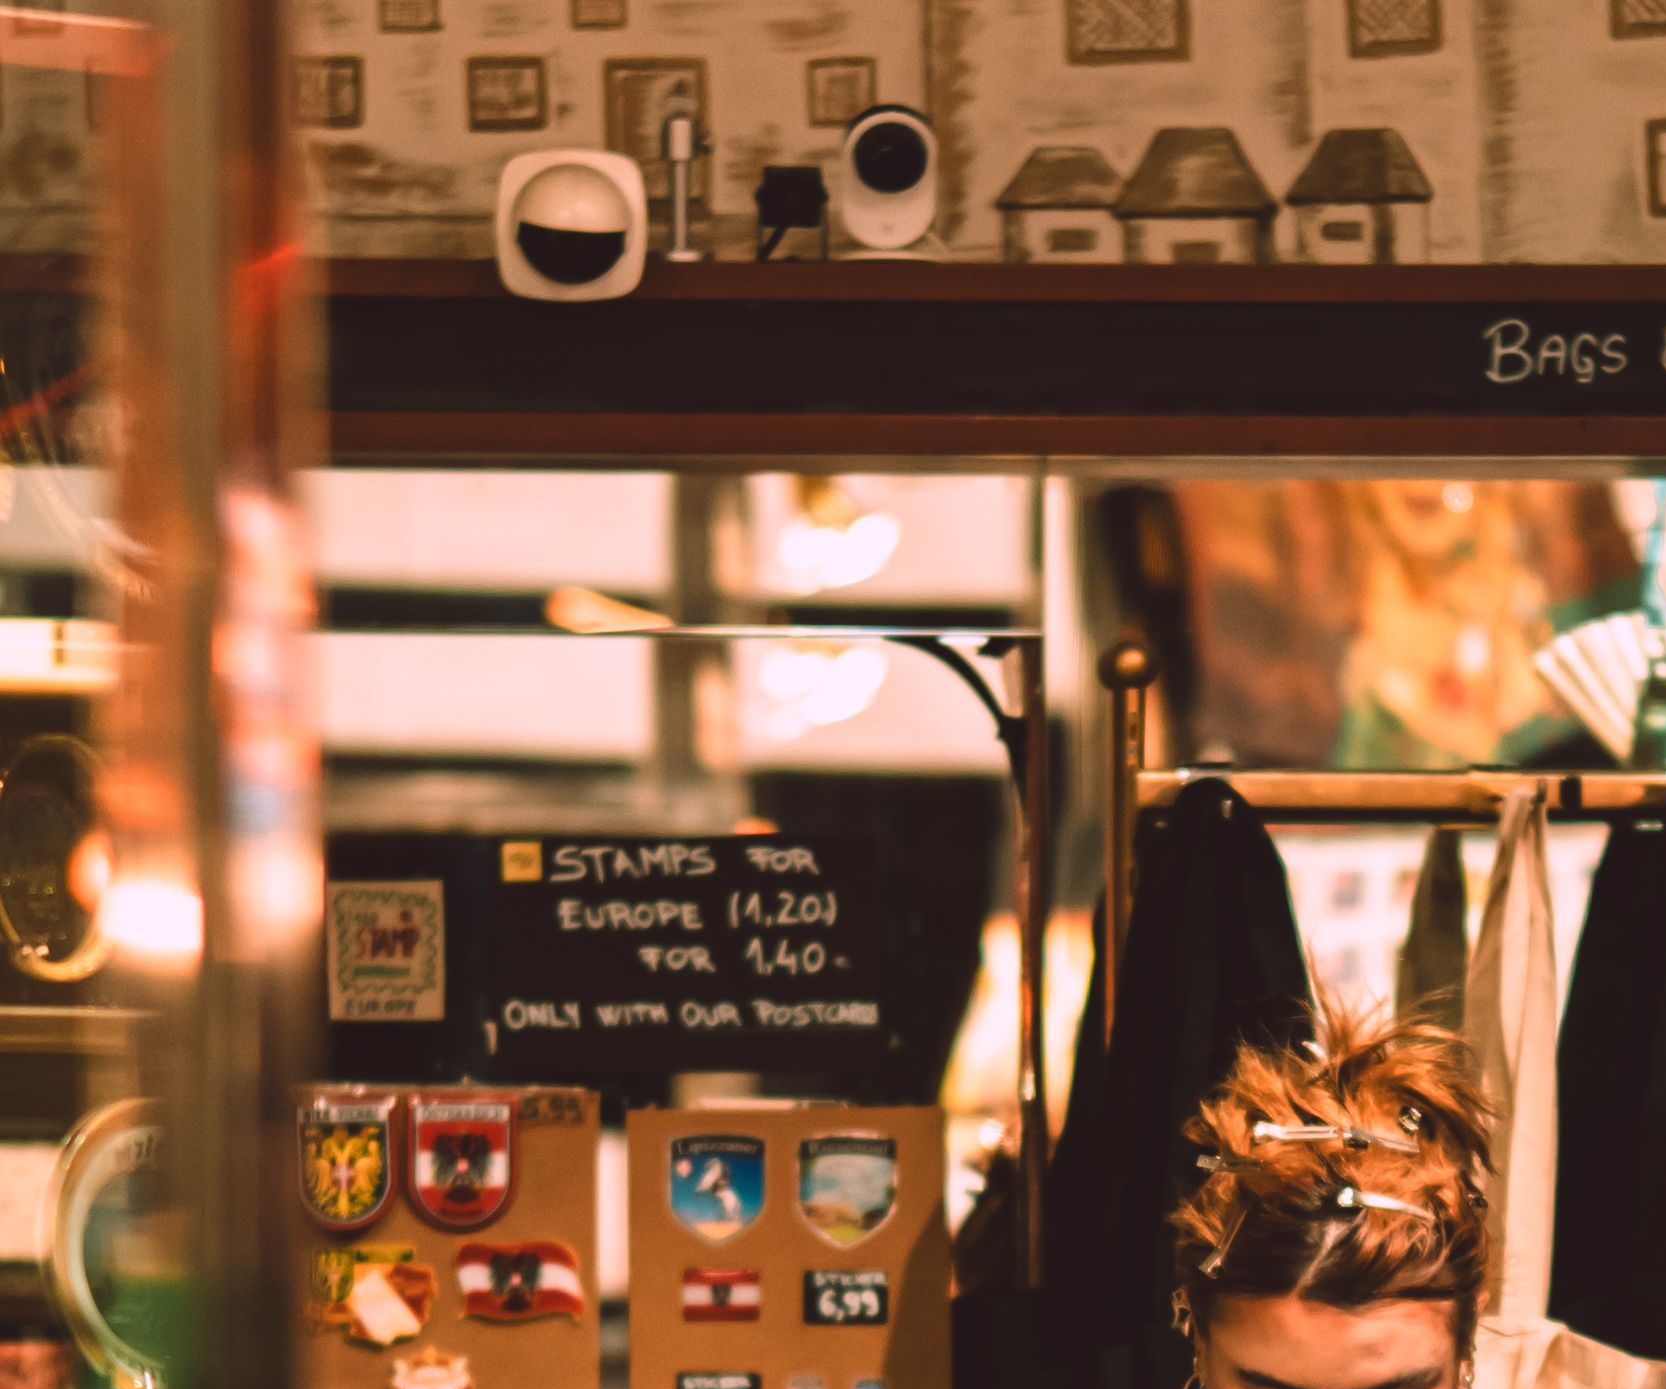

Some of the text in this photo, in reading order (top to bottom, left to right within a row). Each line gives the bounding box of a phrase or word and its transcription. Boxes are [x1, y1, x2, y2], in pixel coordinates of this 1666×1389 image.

[550, 845, 819, 882] STAMPS FOR
[558, 899, 703, 930] EUROPE
[638, 946, 716, 973] FOR
[504, 1001, 580, 1030] ONLY
[597, 1003, 669, 1027] WITH
[680, 1002, 743, 1028] OUR
